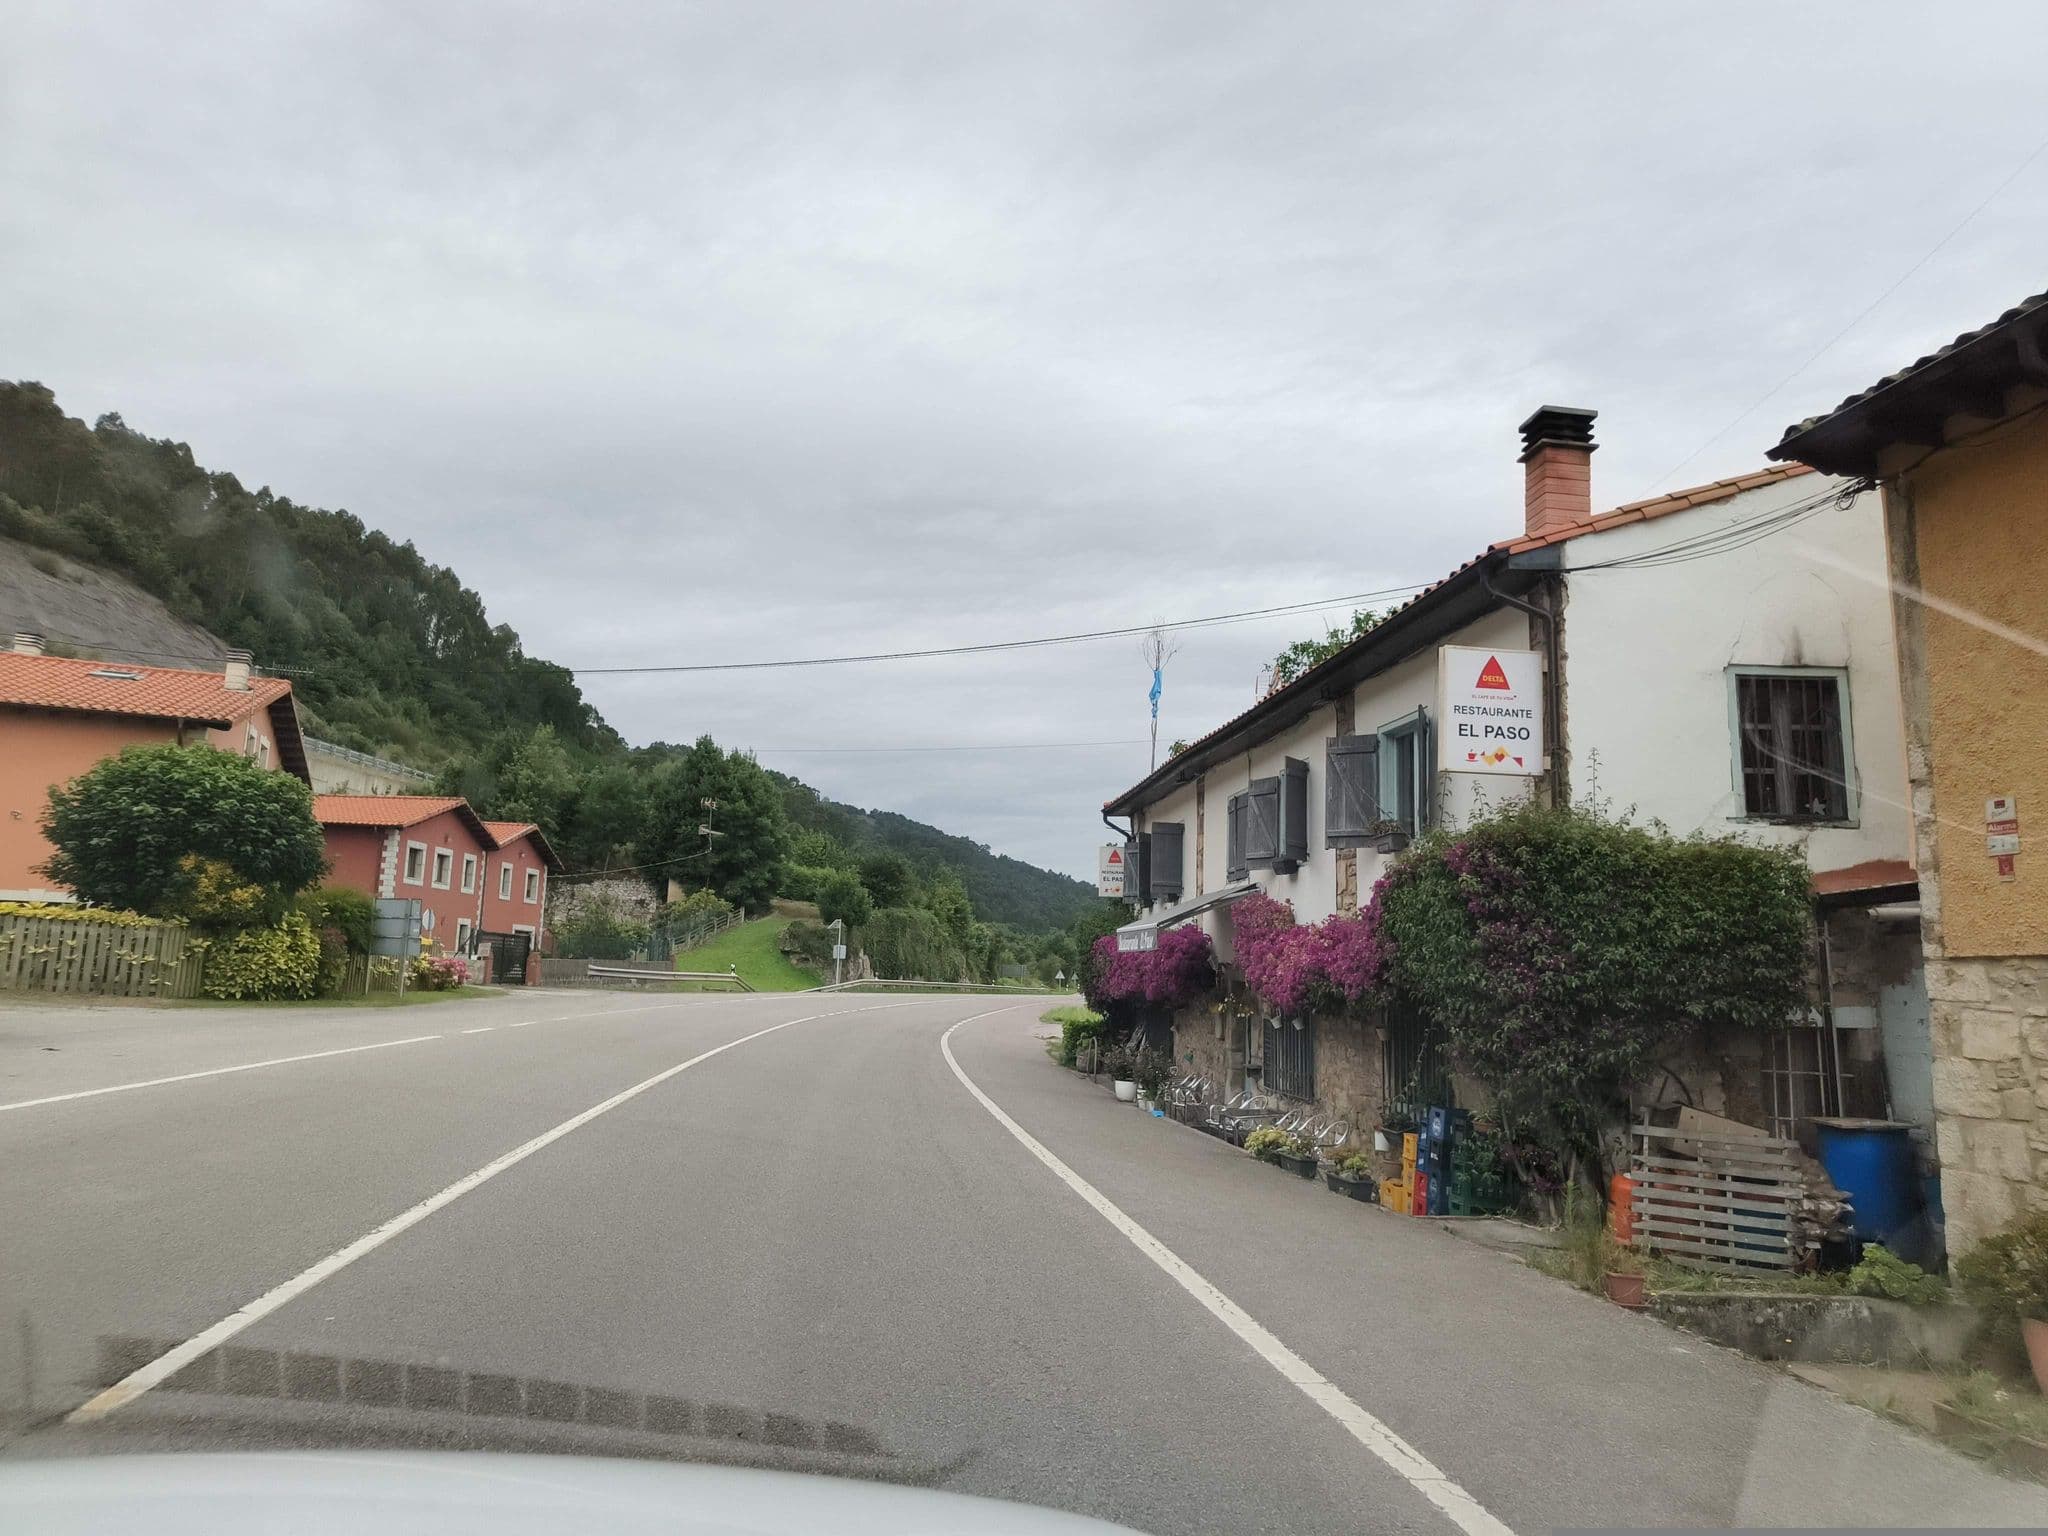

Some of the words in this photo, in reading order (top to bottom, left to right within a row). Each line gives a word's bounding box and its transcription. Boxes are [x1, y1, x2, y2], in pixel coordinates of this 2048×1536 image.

[1454, 704, 1532, 718] RESTAURANTE
[1458, 724, 1479, 737] EL
[1484, 725, 1530, 740] PASO
